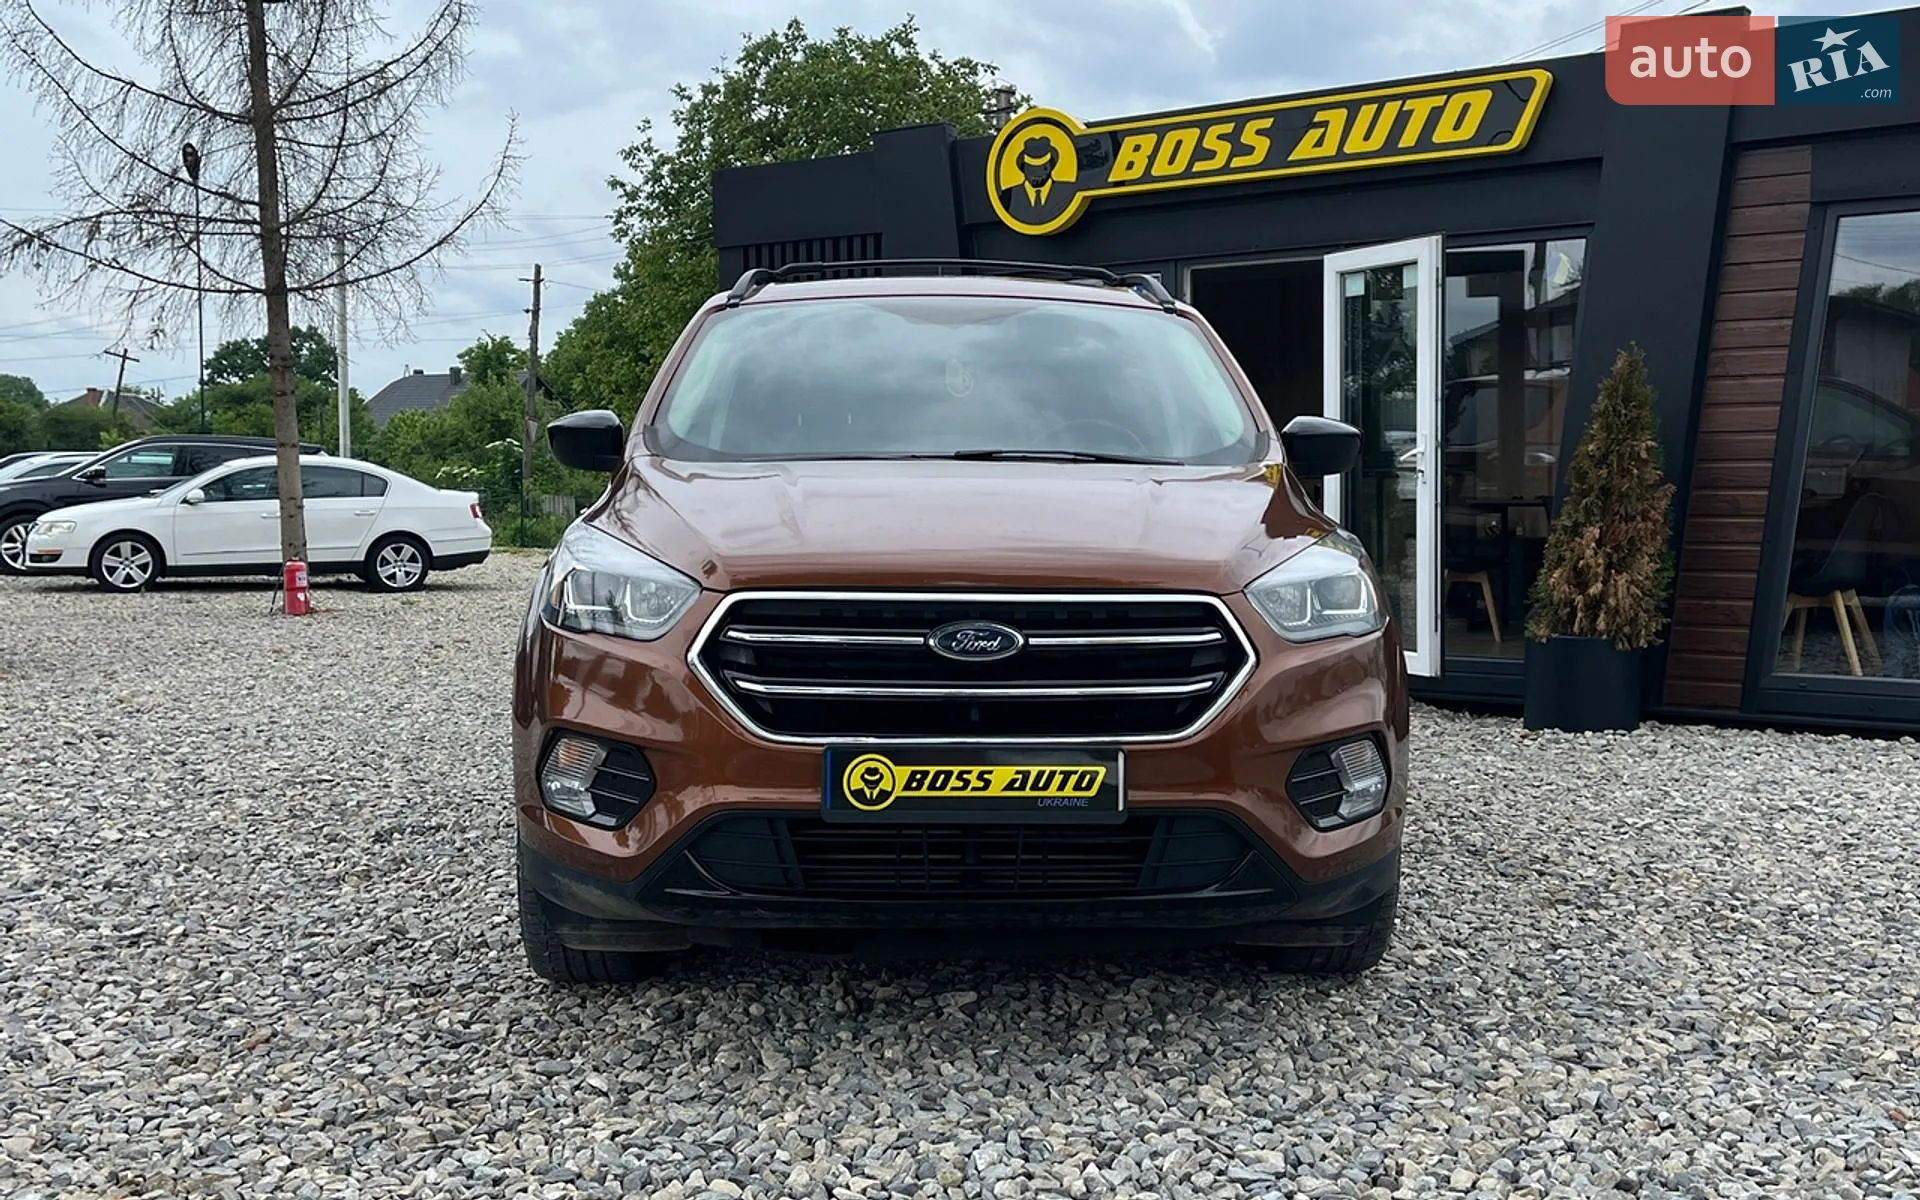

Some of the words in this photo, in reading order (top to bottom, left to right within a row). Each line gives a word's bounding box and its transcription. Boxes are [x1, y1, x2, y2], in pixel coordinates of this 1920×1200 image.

[1107, 116, 1275, 183] BOSS
[1288, 89, 1494, 162] AUTO
[951, 630, 1002, 652] Ford
[901, 769, 994, 792] BOSS
[1001, 769, 1103, 792] AUTO
[1037, 797, 1089, 808] UKRAINE
